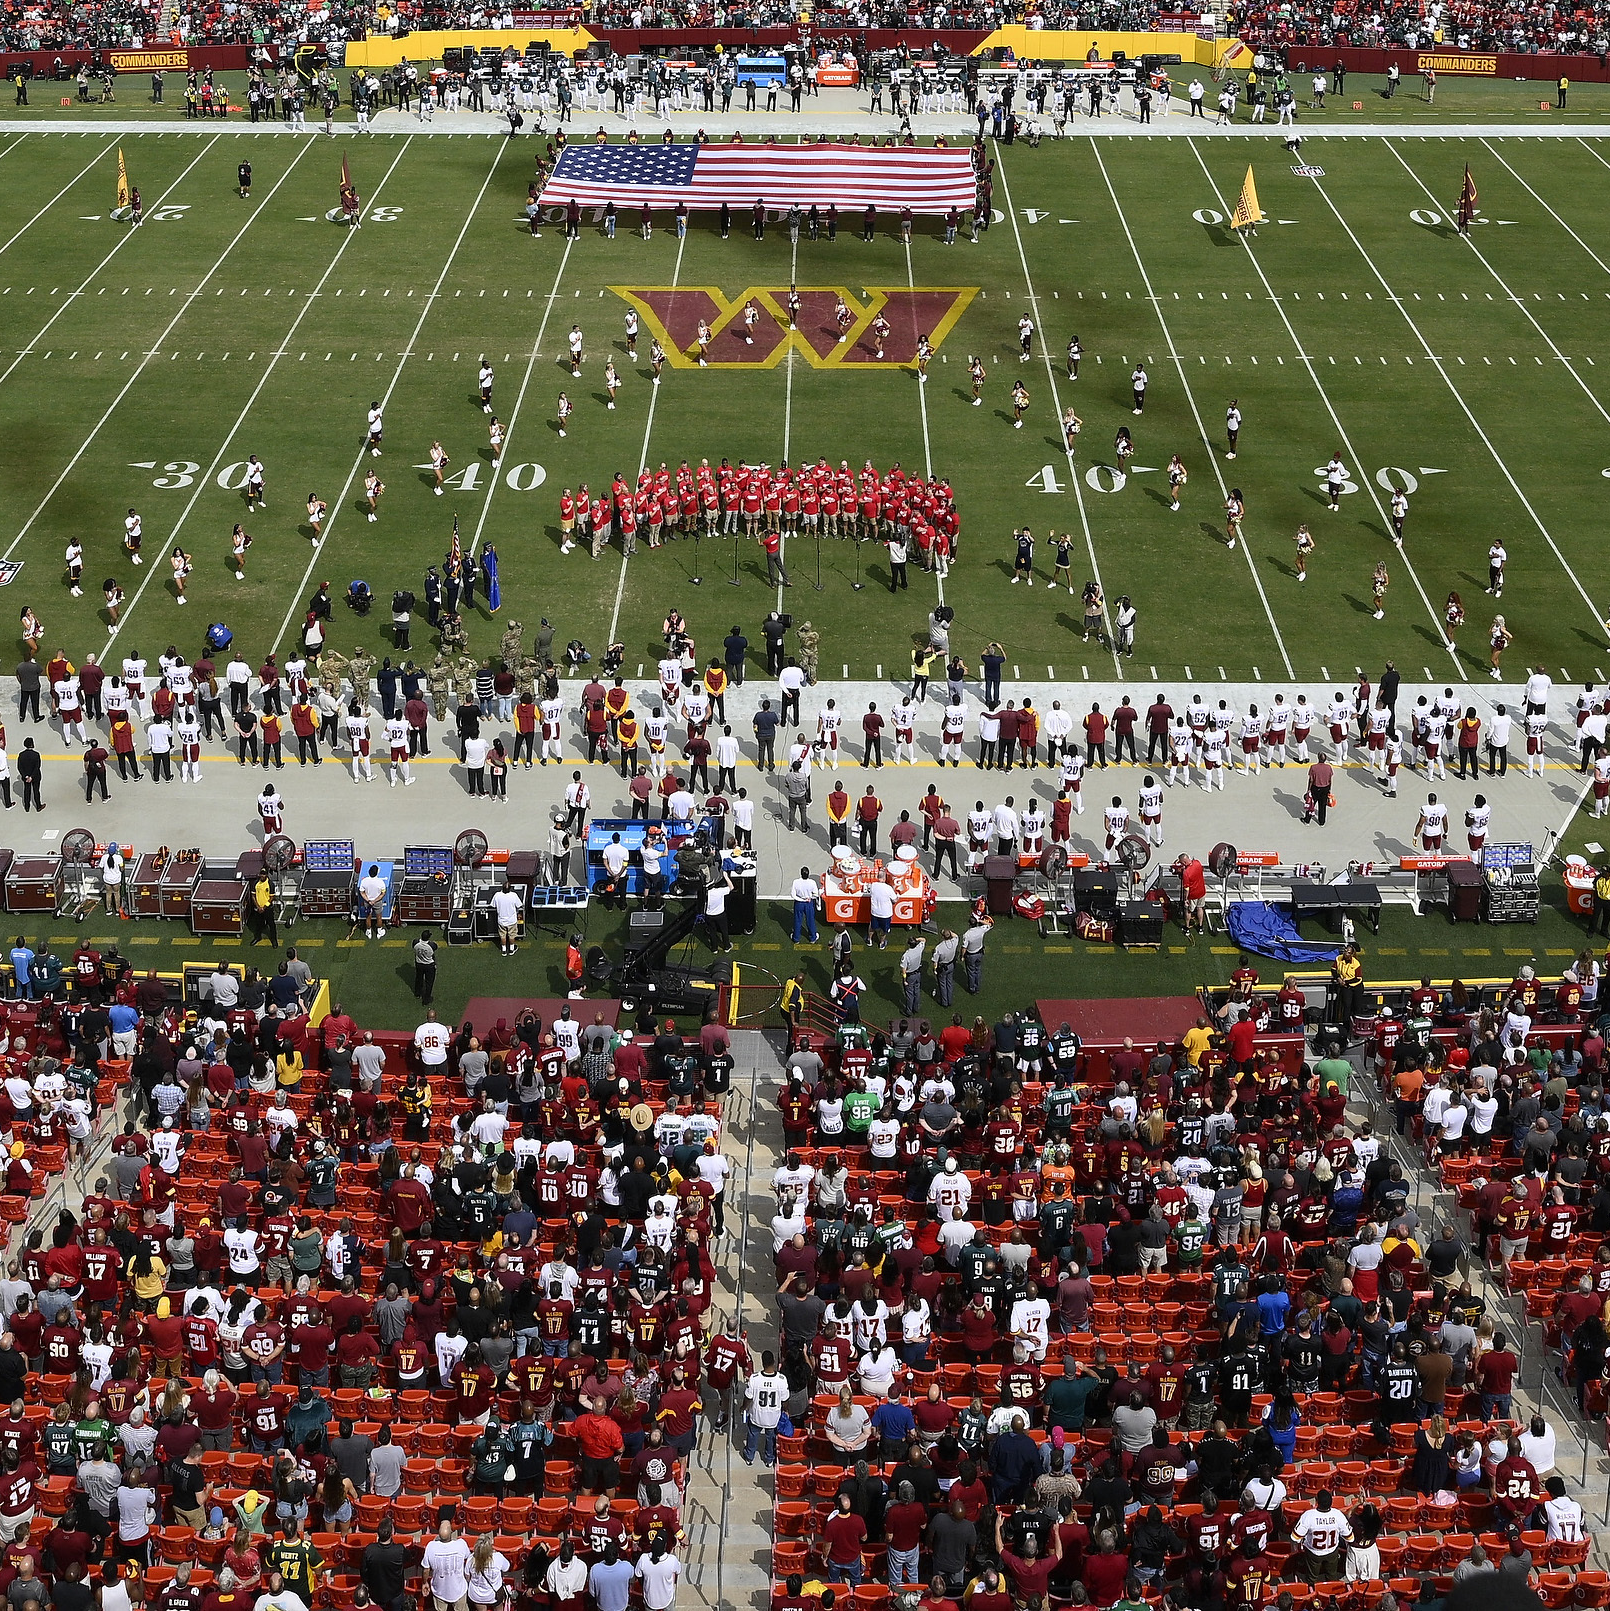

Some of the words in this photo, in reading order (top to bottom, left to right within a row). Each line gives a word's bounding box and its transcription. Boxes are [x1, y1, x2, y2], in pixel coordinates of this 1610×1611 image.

[110, 55, 188, 68] COMMANDERS
[1418, 57, 1496, 71] COMMANDERS
[443, 462, 547, 493] 40
[1024, 463, 1128, 495] 40
[392, 729, 403, 739] 82
[1068, 765, 1080, 775] 20
[1147, 795, 1158, 806] 37
[263, 805, 274, 815] 41
[833, 898, 854, 919] G
[426, 1036, 439, 1048] 86
[852, 1106, 870, 1120] 92
[941, 1189, 957, 1207] 21
[1314, 1516, 1338, 1525] TAYLOR
[1312, 1530, 1337, 1550] 21
